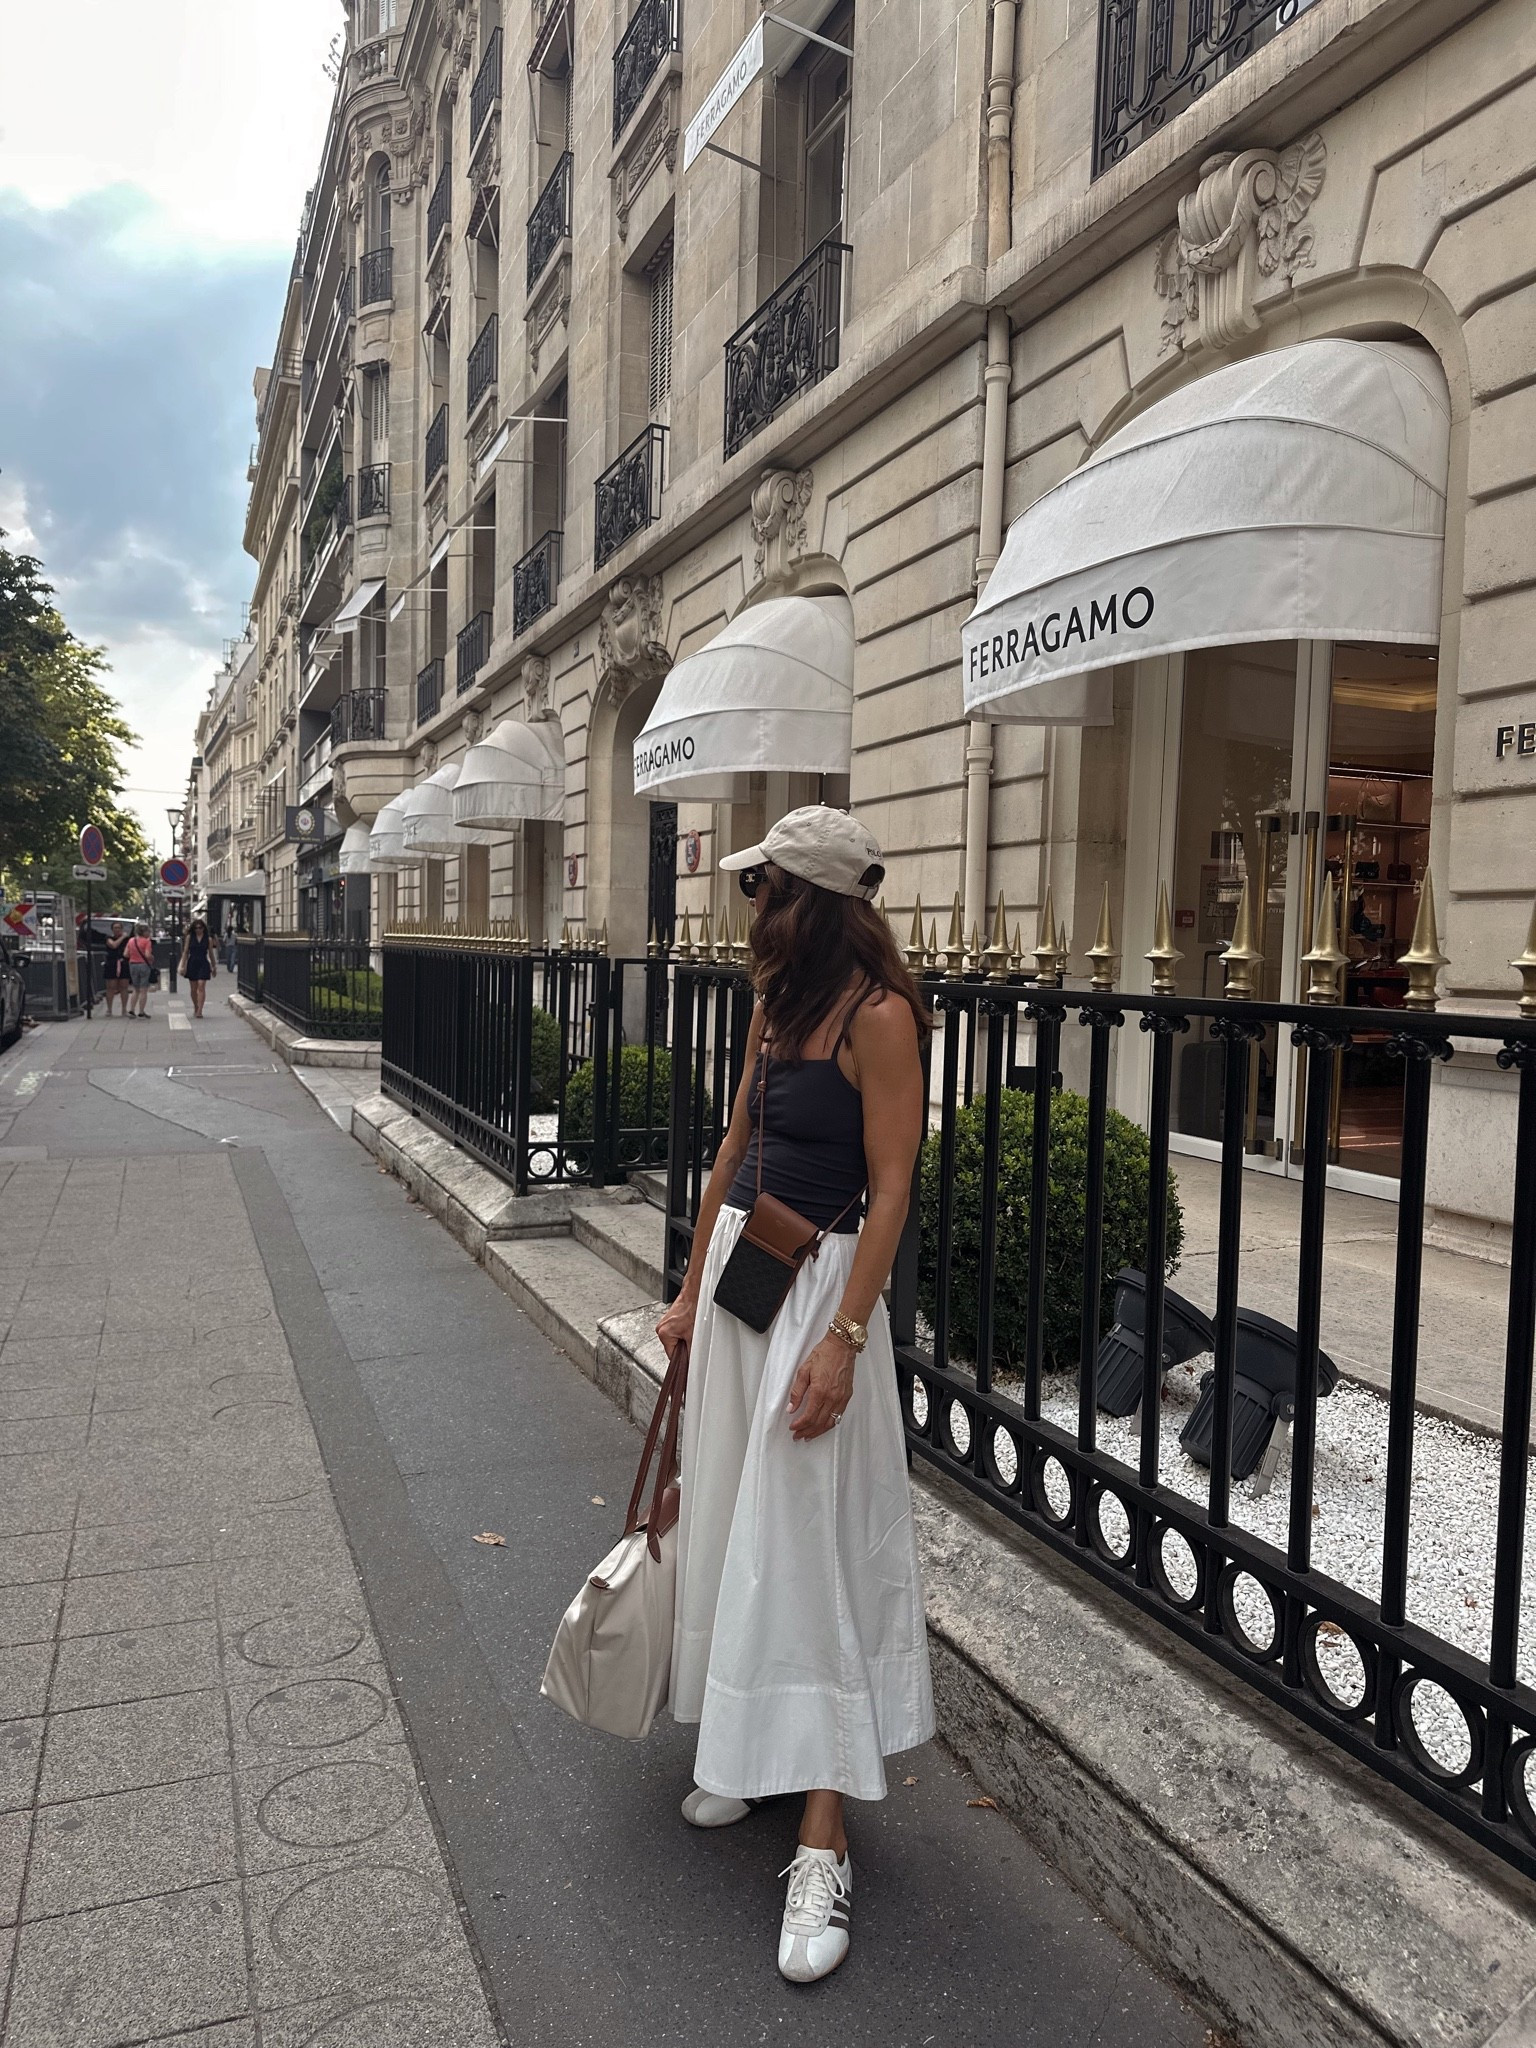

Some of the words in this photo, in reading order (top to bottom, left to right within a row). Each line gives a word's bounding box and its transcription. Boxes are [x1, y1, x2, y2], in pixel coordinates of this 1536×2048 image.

[695, 60, 747, 147] FERRAGAMO
[969, 586, 1155, 683] FERRAGAMO
[1496, 722, 1536, 758] FE
